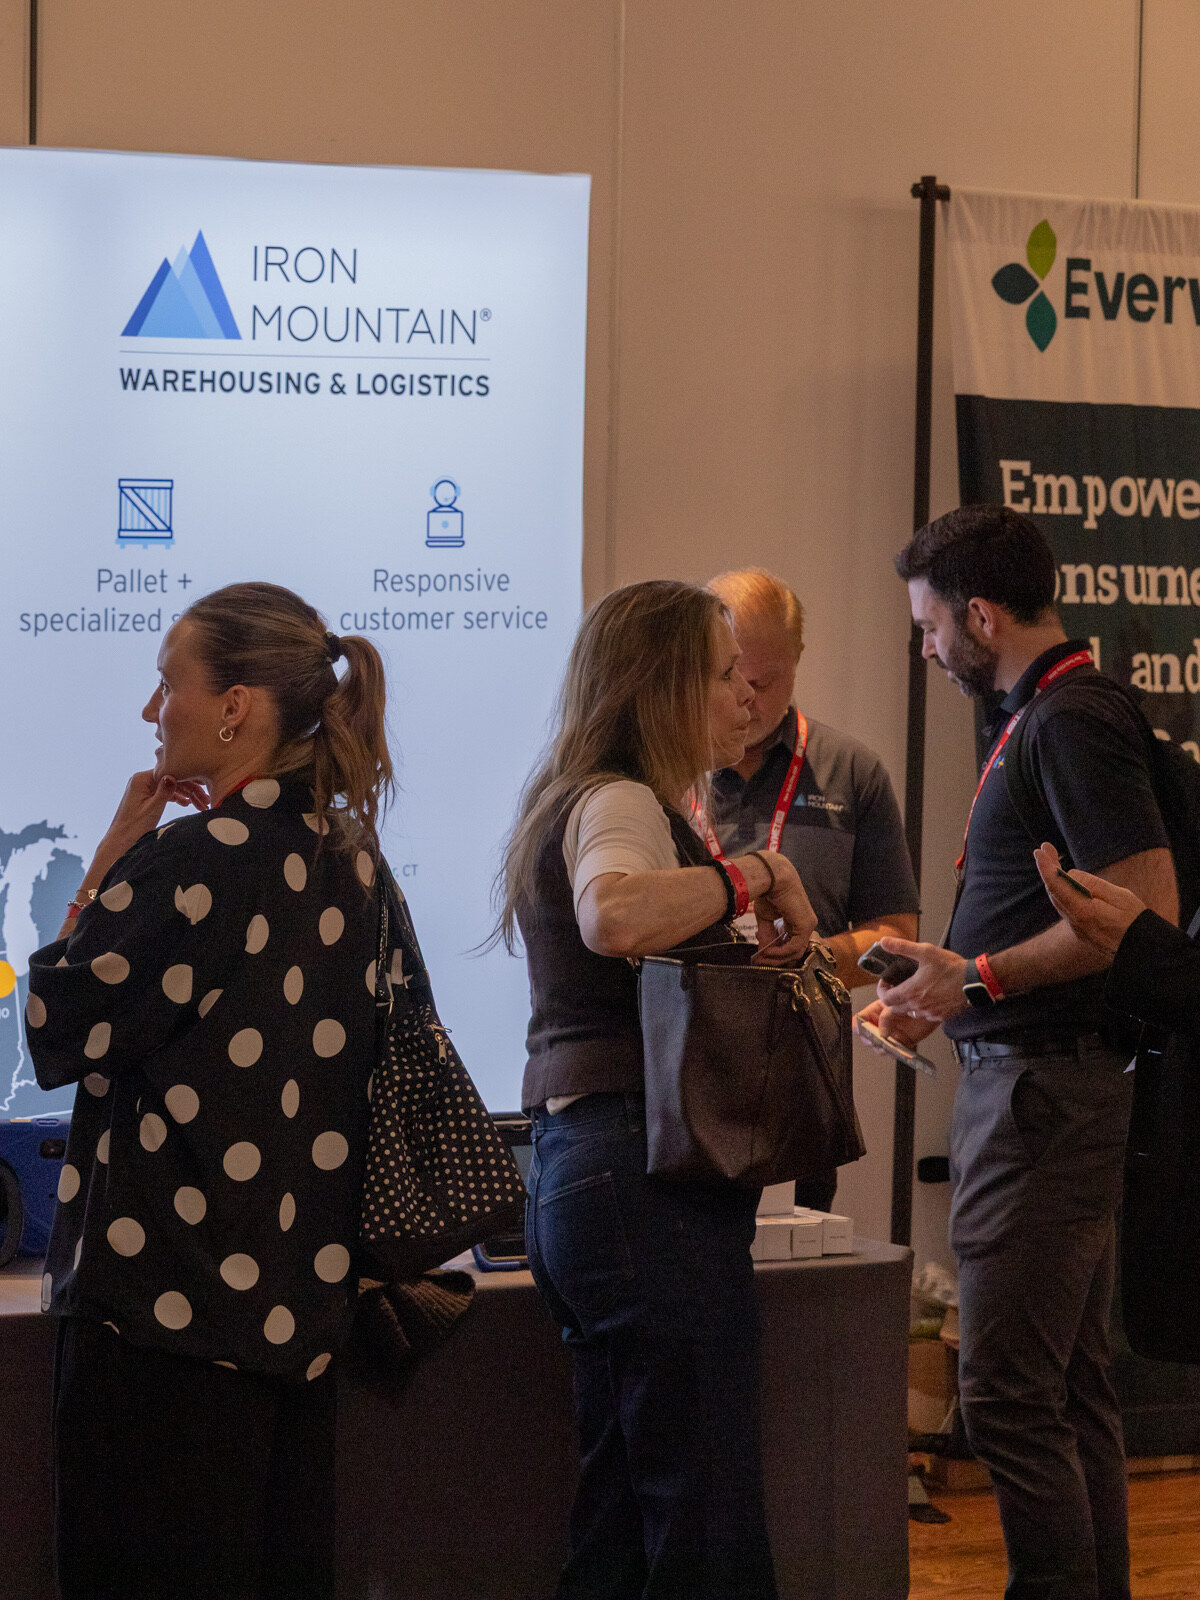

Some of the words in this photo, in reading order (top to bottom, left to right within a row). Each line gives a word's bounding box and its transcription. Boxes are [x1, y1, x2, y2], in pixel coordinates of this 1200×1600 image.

[253, 245, 357, 284] IRON
[119, 367, 321, 396] WAREHOUSING
[329, 372, 347, 396] &
[356, 373, 490, 397] LOGISTICS
[97, 568, 168, 593] Pallet
[373, 567, 510, 597] Responsive
[19, 607, 162, 637] specialized
[340, 606, 455, 631] customer
[463, 605, 548, 629] service
[808, 794, 825, 802] IRON
[769, 823, 783, 852] EVNET
[402, 864, 418, 877] CT
